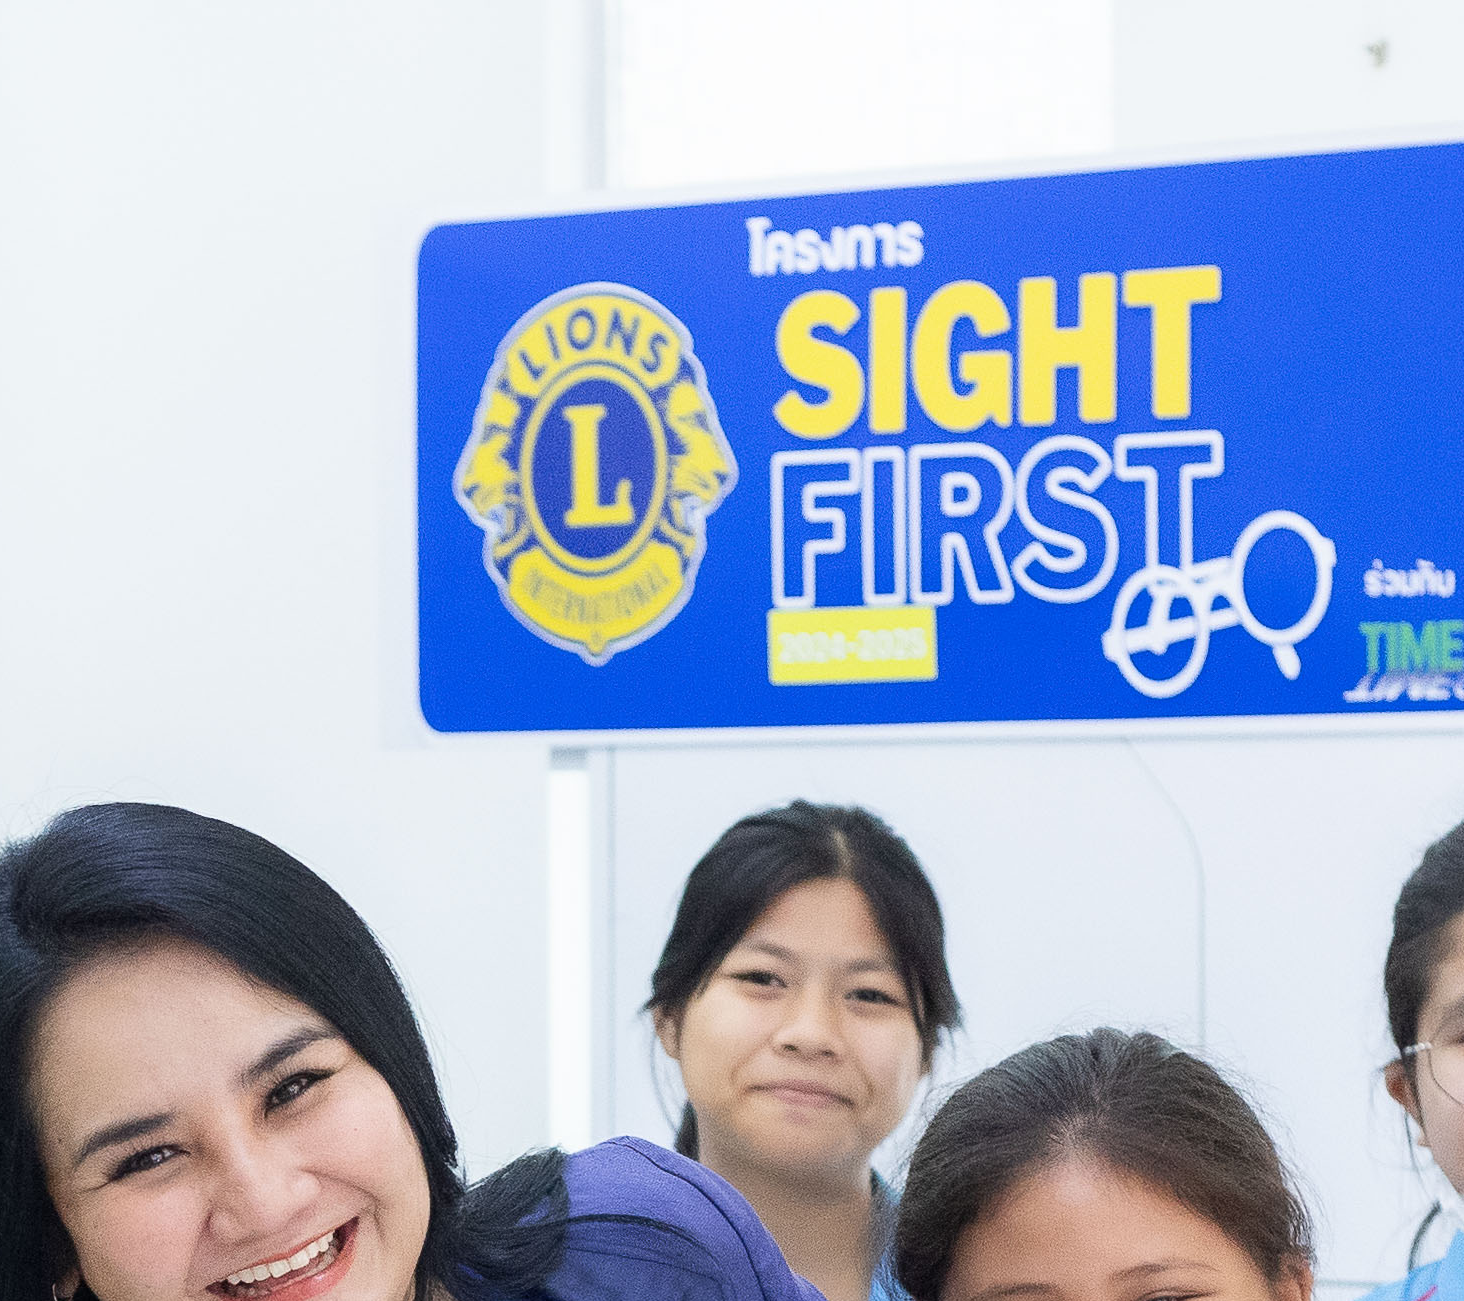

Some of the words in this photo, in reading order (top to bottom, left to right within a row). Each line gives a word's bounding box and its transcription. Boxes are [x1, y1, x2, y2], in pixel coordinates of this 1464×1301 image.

[745, 216, 924, 277] โครงการ
[519, 307, 673, 380] LIONS
[772, 263, 1223, 440] SIGHT
[561, 403, 636, 527] L
[771, 430, 1224, 607] FIRST
